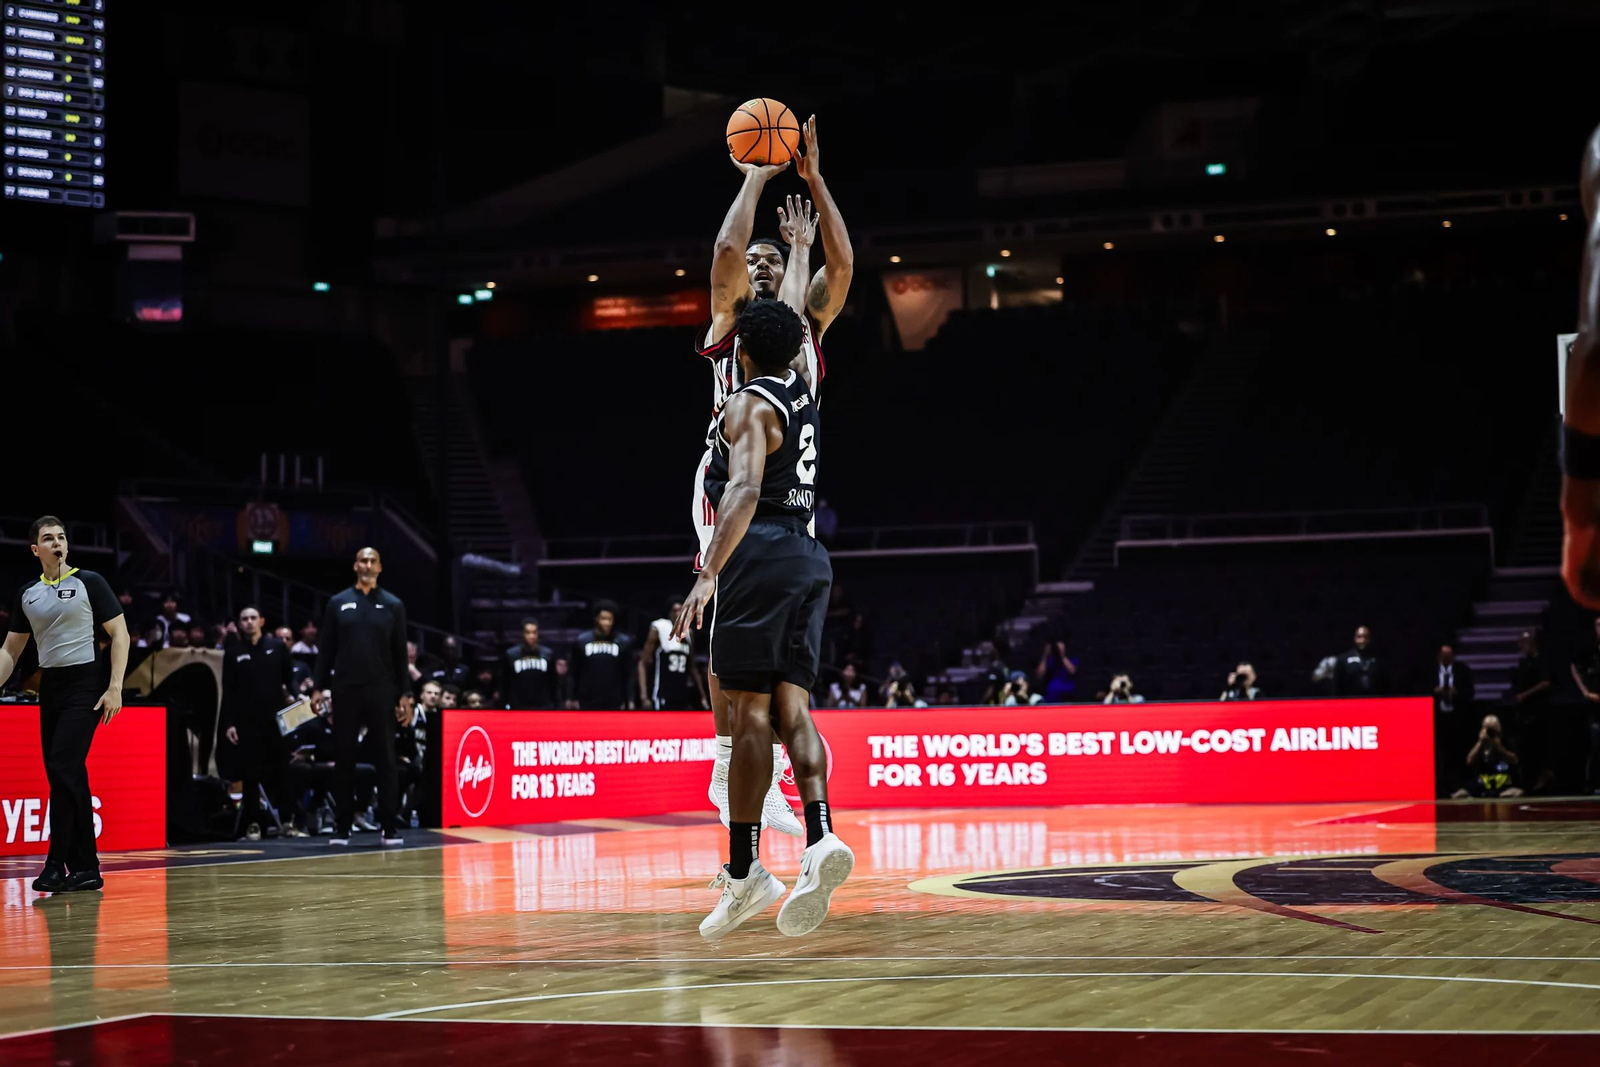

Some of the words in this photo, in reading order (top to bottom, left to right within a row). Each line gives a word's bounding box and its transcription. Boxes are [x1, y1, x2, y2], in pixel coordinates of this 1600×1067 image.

[796, 424, 818, 484] 2
[783, 488, 815, 511] RAND
[511, 741, 538, 767] THE
[538, 740, 594, 766] WORLD'S
[594, 740, 624, 765] BEST
[624, 739, 681, 763] LOW-COST
[868, 736, 919, 759] THE
[922, 733, 1045, 757] WORLD'S
[1048, 732, 1116, 756] BEST
[1119, 729, 1266, 754] LOW-COST
[1270, 726, 1378, 752] AIRLINE
[511, 774, 539, 800] FOR
[539, 773, 554, 798] 16
[555, 772, 595, 798] YEARS
[868, 763, 922, 787] FOR
[926, 763, 956, 786] 16
[960, 761, 1048, 785] YEARS
[2, 795, 103, 844] YES
